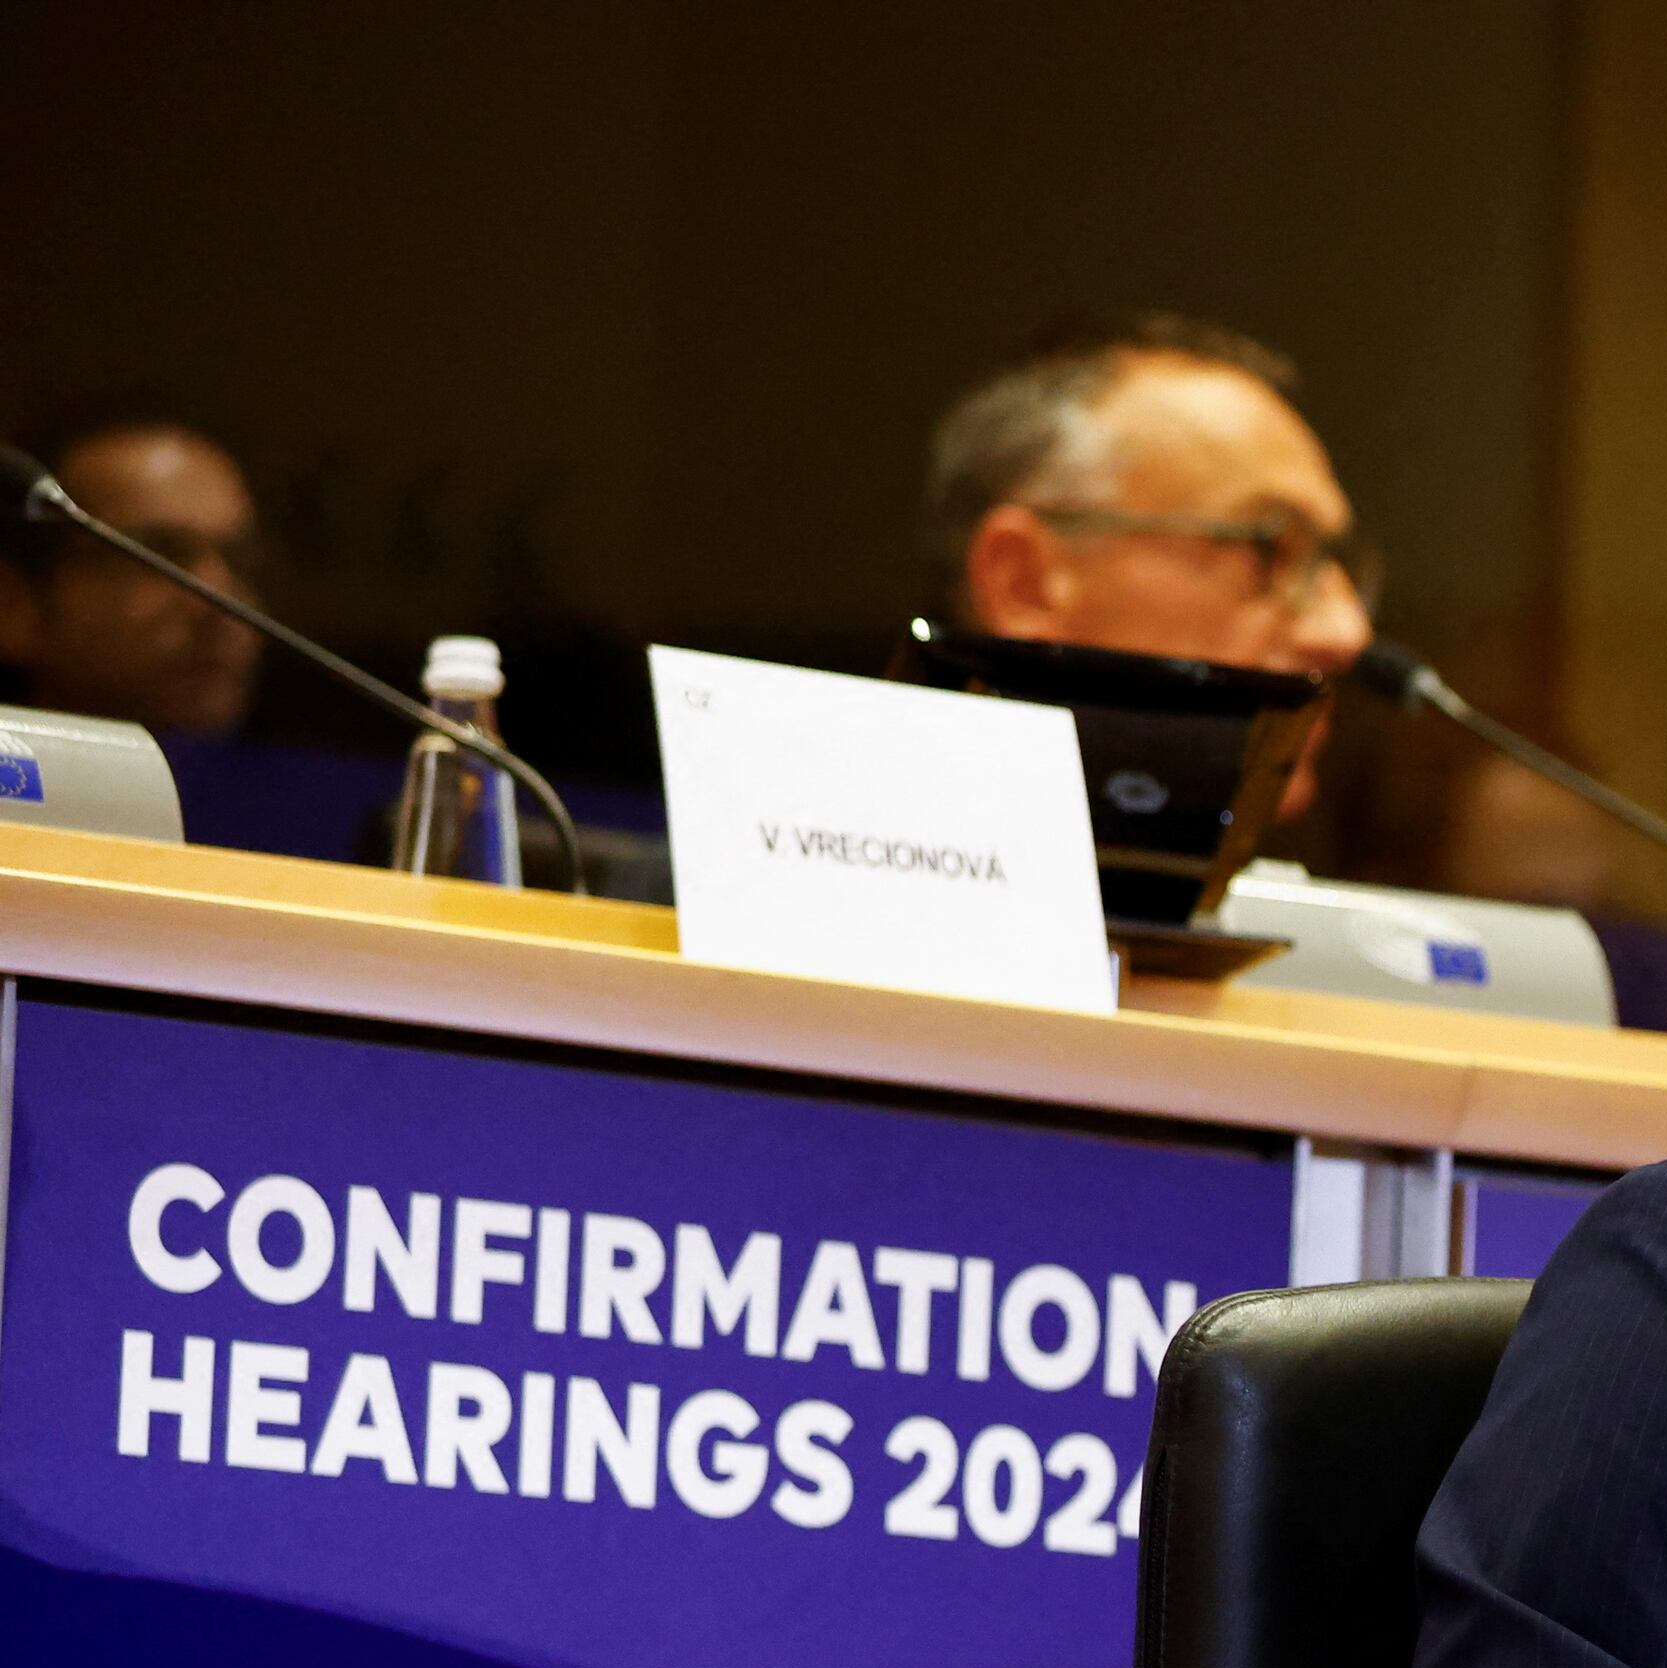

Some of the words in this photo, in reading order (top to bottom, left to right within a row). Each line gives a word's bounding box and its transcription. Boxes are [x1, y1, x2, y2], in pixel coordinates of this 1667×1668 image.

[127, 1161, 1198, 1400] CONFIRMATION
[116, 1328, 855, 1530] HEARINGS
[883, 1414, 1144, 1558] 202
